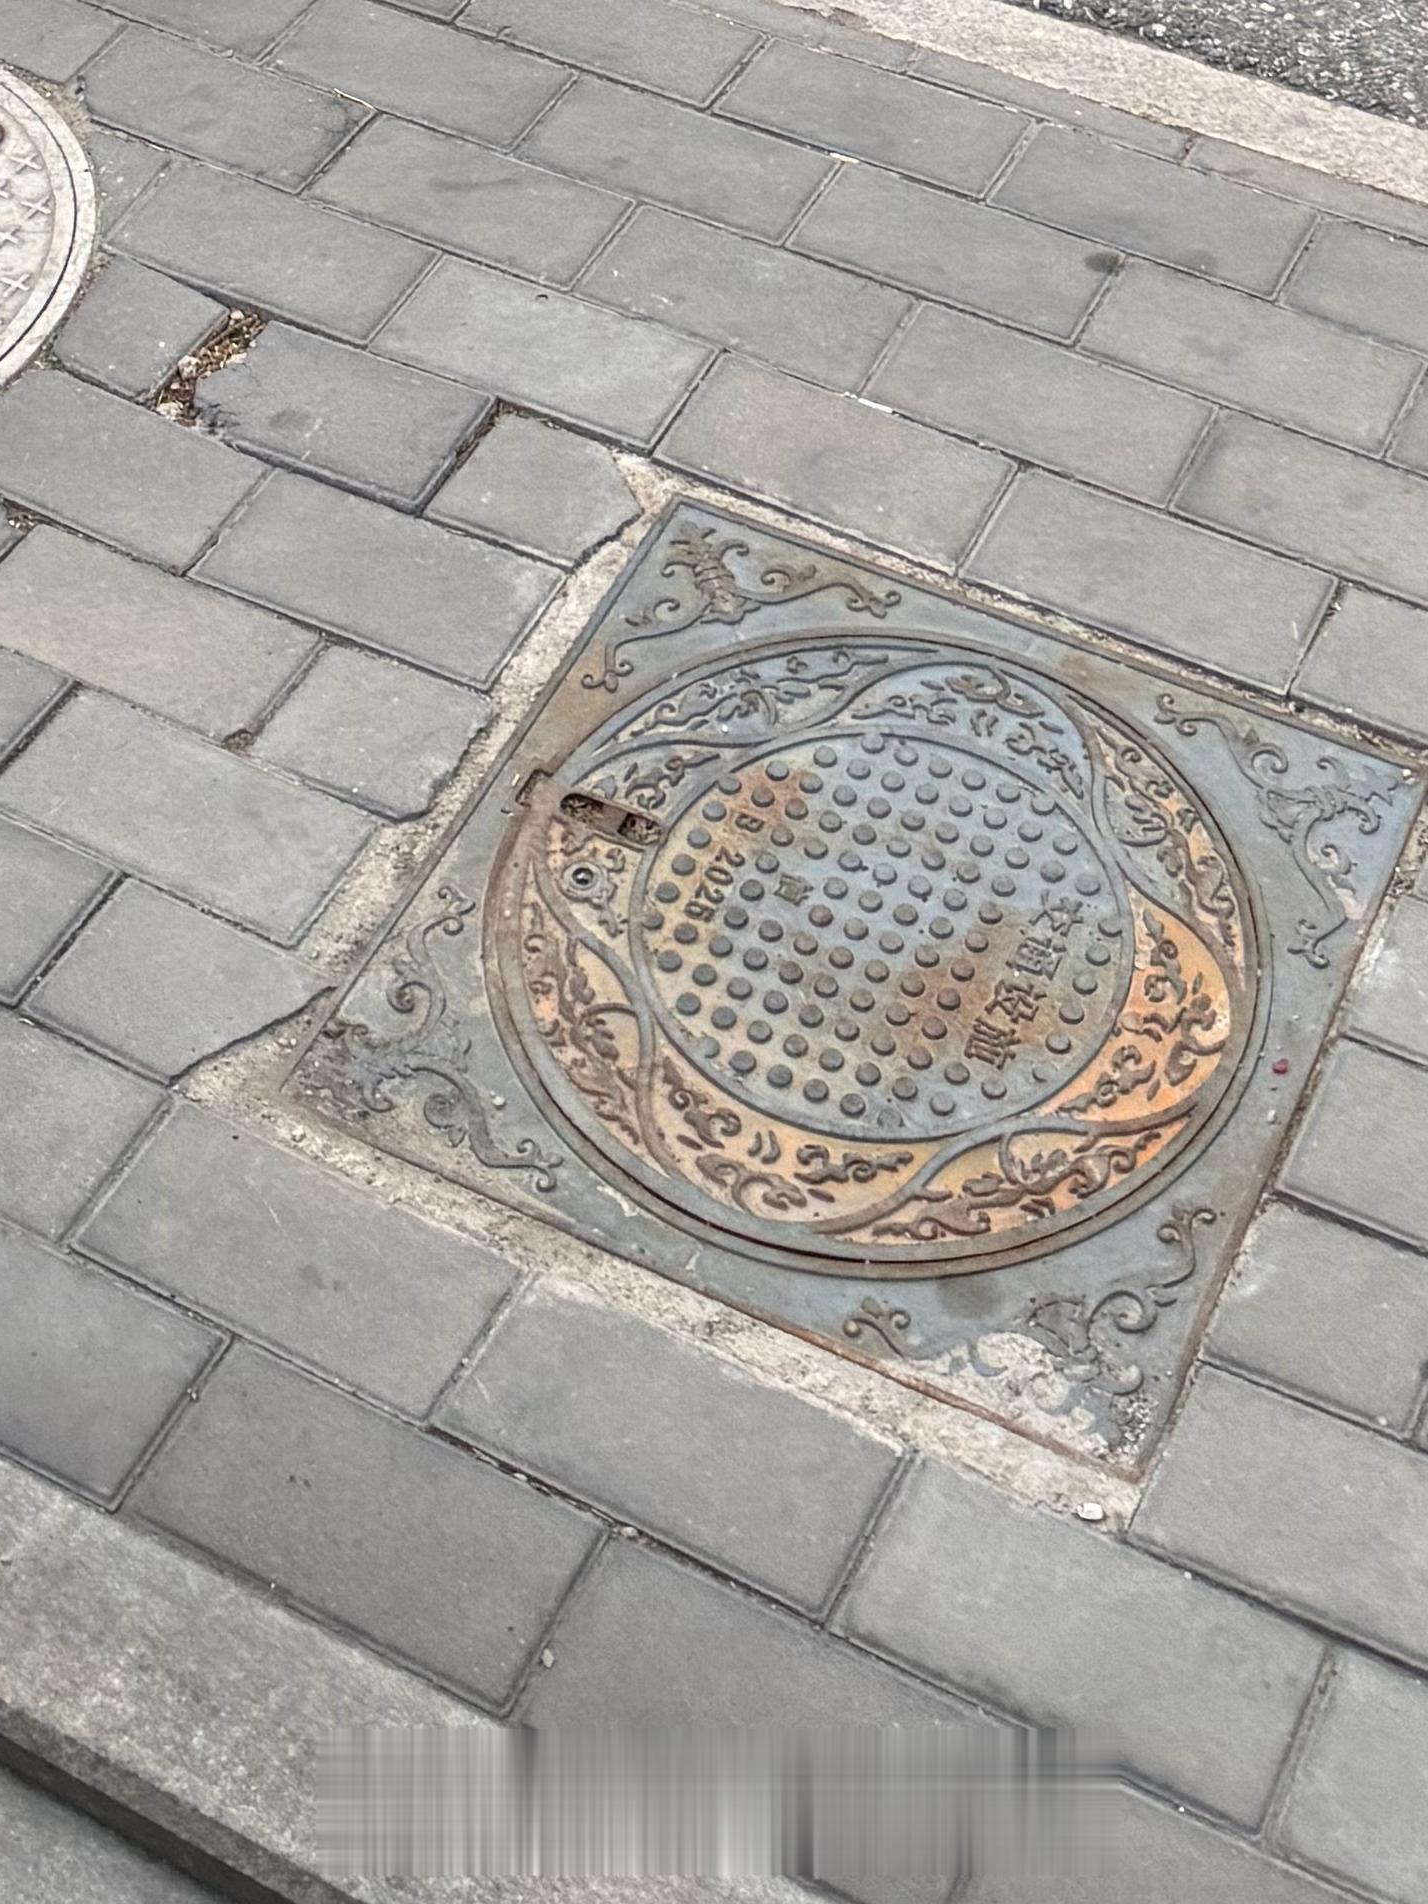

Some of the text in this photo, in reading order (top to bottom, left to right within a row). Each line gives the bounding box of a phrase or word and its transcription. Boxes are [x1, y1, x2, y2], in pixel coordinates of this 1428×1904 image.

[734, 812, 766, 834] B
[962, 887, 1087, 1075] 交通设施
